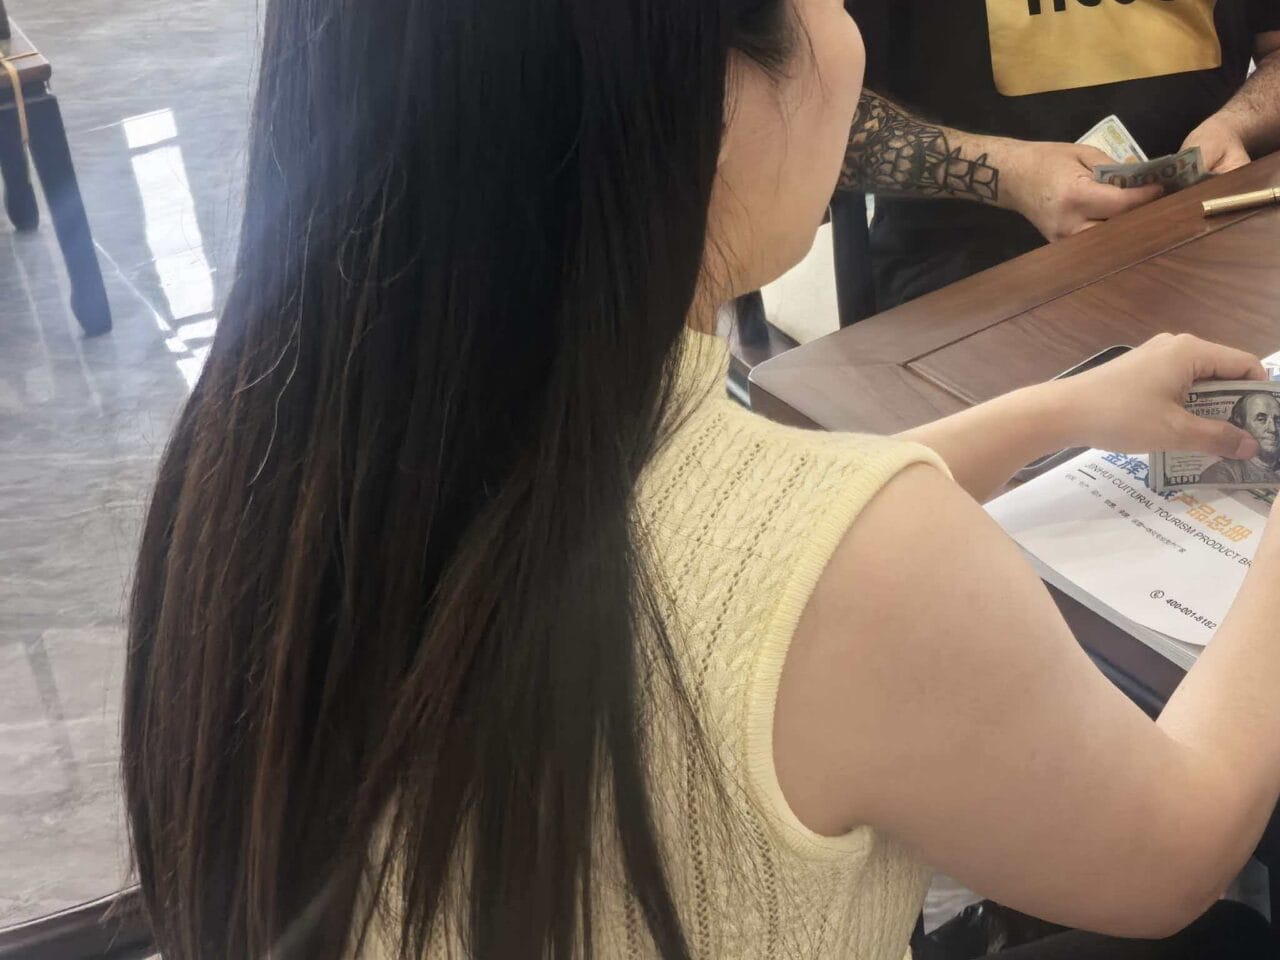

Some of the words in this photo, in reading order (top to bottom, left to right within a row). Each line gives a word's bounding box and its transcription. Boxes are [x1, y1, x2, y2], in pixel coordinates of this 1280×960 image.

[1155, 507, 1197, 537] TOURISM
[1194, 531, 1242, 560] PRODUCT
[1168, 492, 1254, 543] 产品总册
